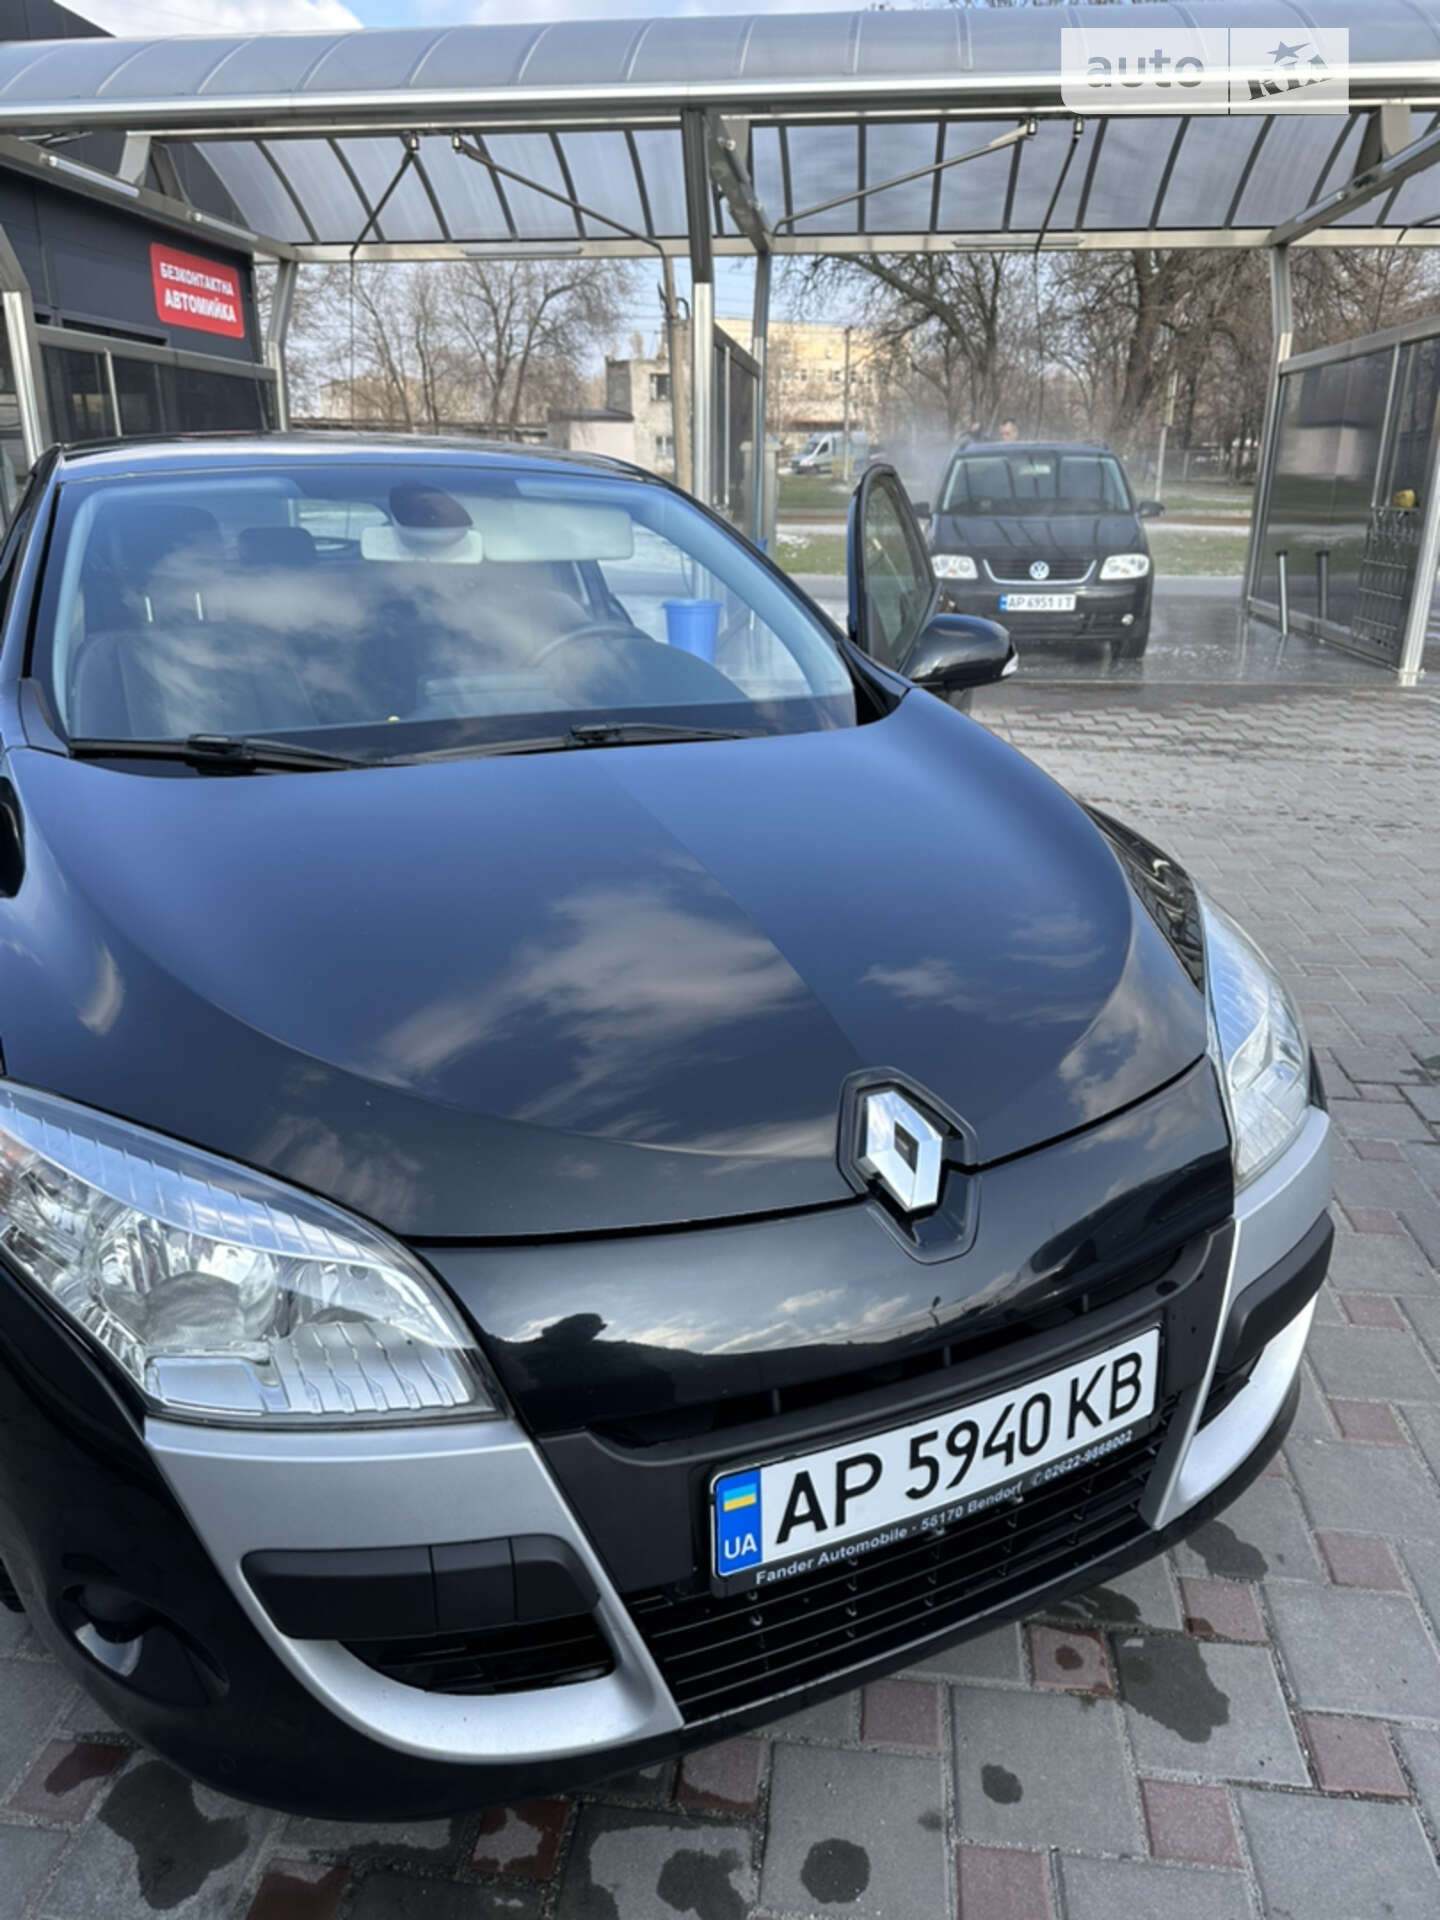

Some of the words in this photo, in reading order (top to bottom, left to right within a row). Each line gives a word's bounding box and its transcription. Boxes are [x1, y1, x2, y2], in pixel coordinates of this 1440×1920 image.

[160, 261, 235, 297] БЕЗКОНТАКТНА
[164, 287, 238, 323] АВТОМИЙКА
[776, 1453, 883, 1545] AP
[905, 1393, 1051, 1500] 5940
[1066, 1351, 1143, 1440] KB
[724, 1532, 758, 1560] UA
[755, 1557, 815, 1585] Fander
[817, 1528, 908, 1566] Automobile
[967, 1481, 1024, 1514] Bendorf
